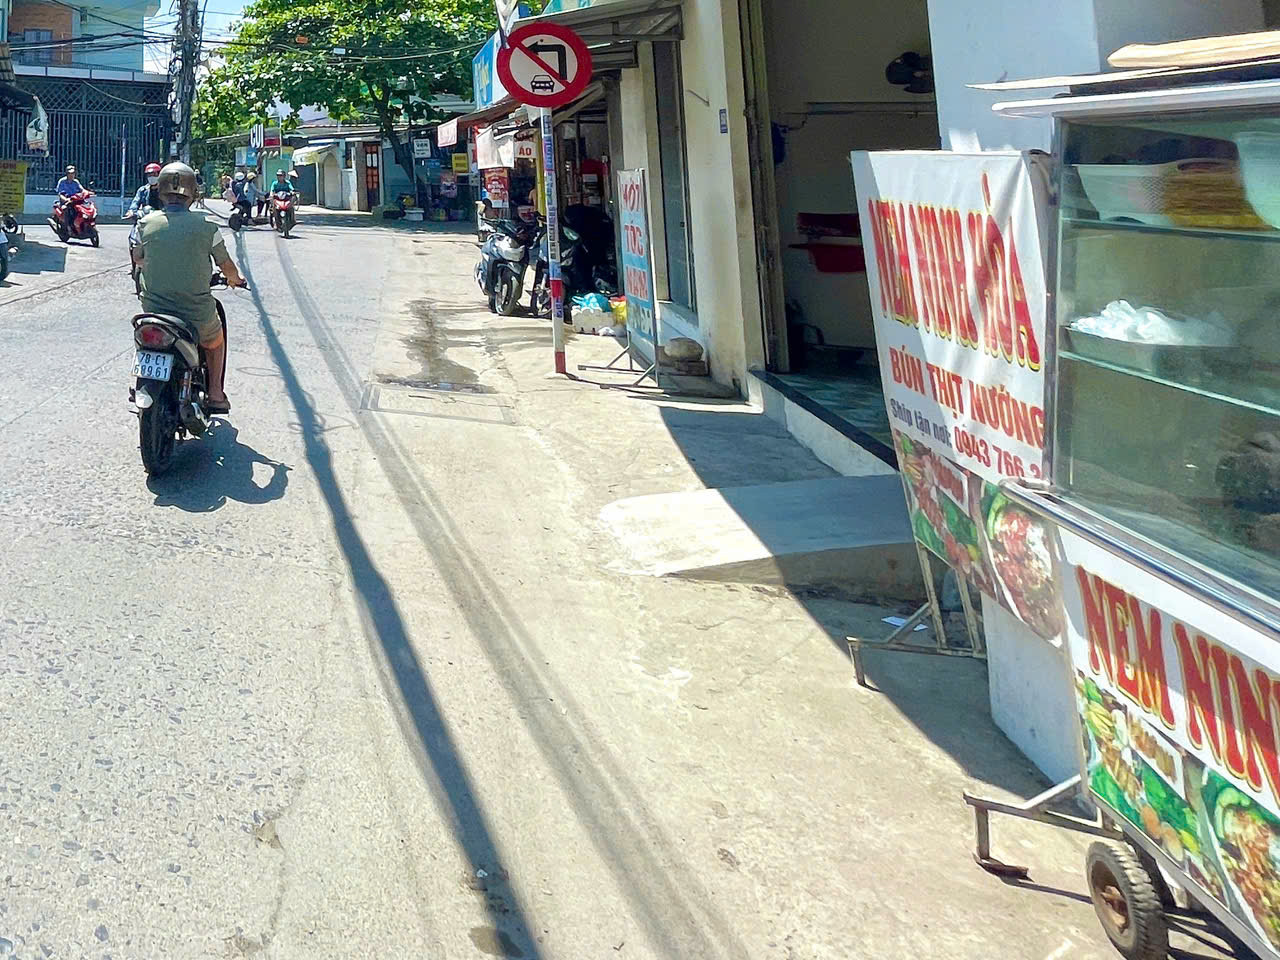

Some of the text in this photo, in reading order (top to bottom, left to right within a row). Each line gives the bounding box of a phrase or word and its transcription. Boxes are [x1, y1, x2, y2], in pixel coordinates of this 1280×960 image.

[867, 197, 920, 330] NEM
[908, 203, 980, 350] NINH
[140, 352, 166, 367] 78-C1
[889, 344, 1045, 450] BÚN THỊT NƯỚNG
[890, 398, 914, 427] Ship
[954, 425, 992, 468] 0943
[1075, 563, 1177, 732] NEM
